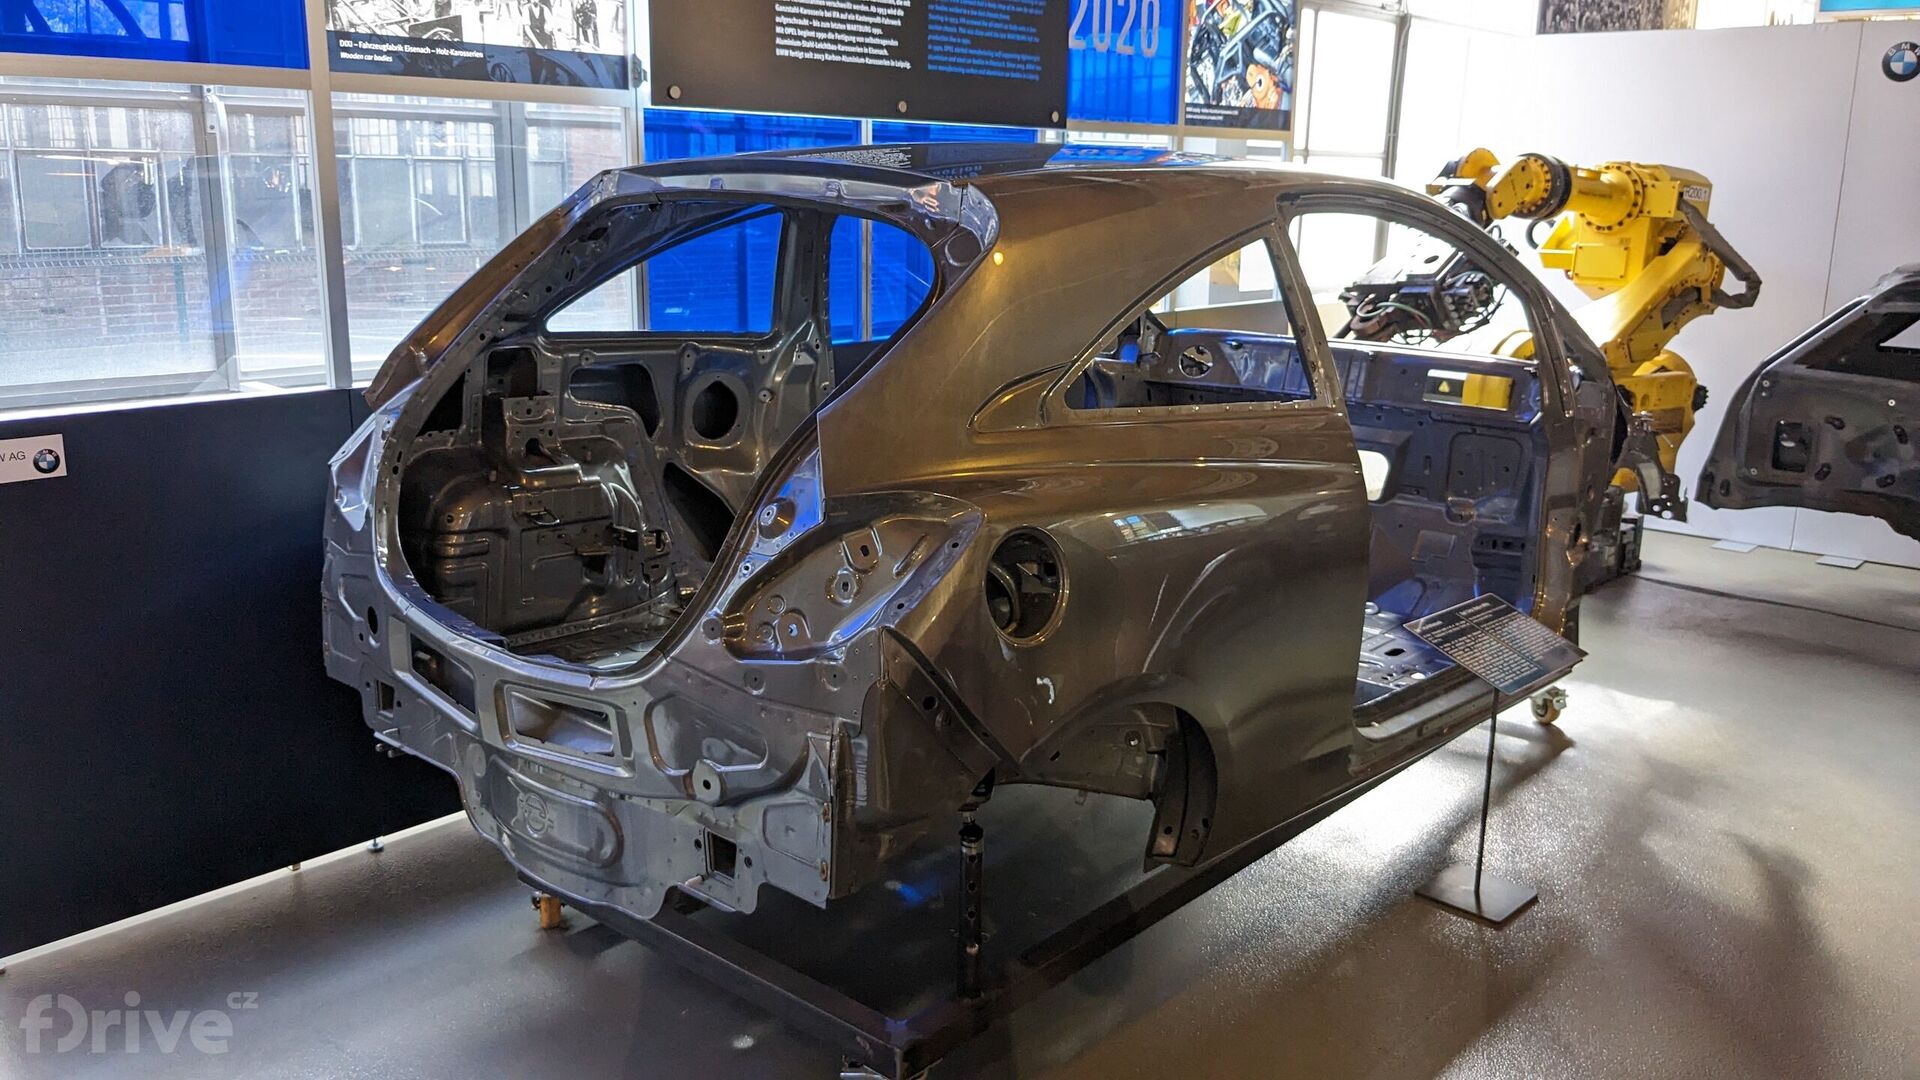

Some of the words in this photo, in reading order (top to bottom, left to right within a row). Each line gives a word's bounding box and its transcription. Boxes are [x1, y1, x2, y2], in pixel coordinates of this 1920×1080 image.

[784, 27, 797, 36] OPEL
[1068, 0, 1160, 57] 2020
[358, 41, 403, 52] Fahrzeugfabrik
[404, 45, 431, 54] Eisenach
[436, 48, 484, 58] Holz-Karosserien
[340, 52, 364, 60] Wooden
[9, 451, 26, 461] AG
